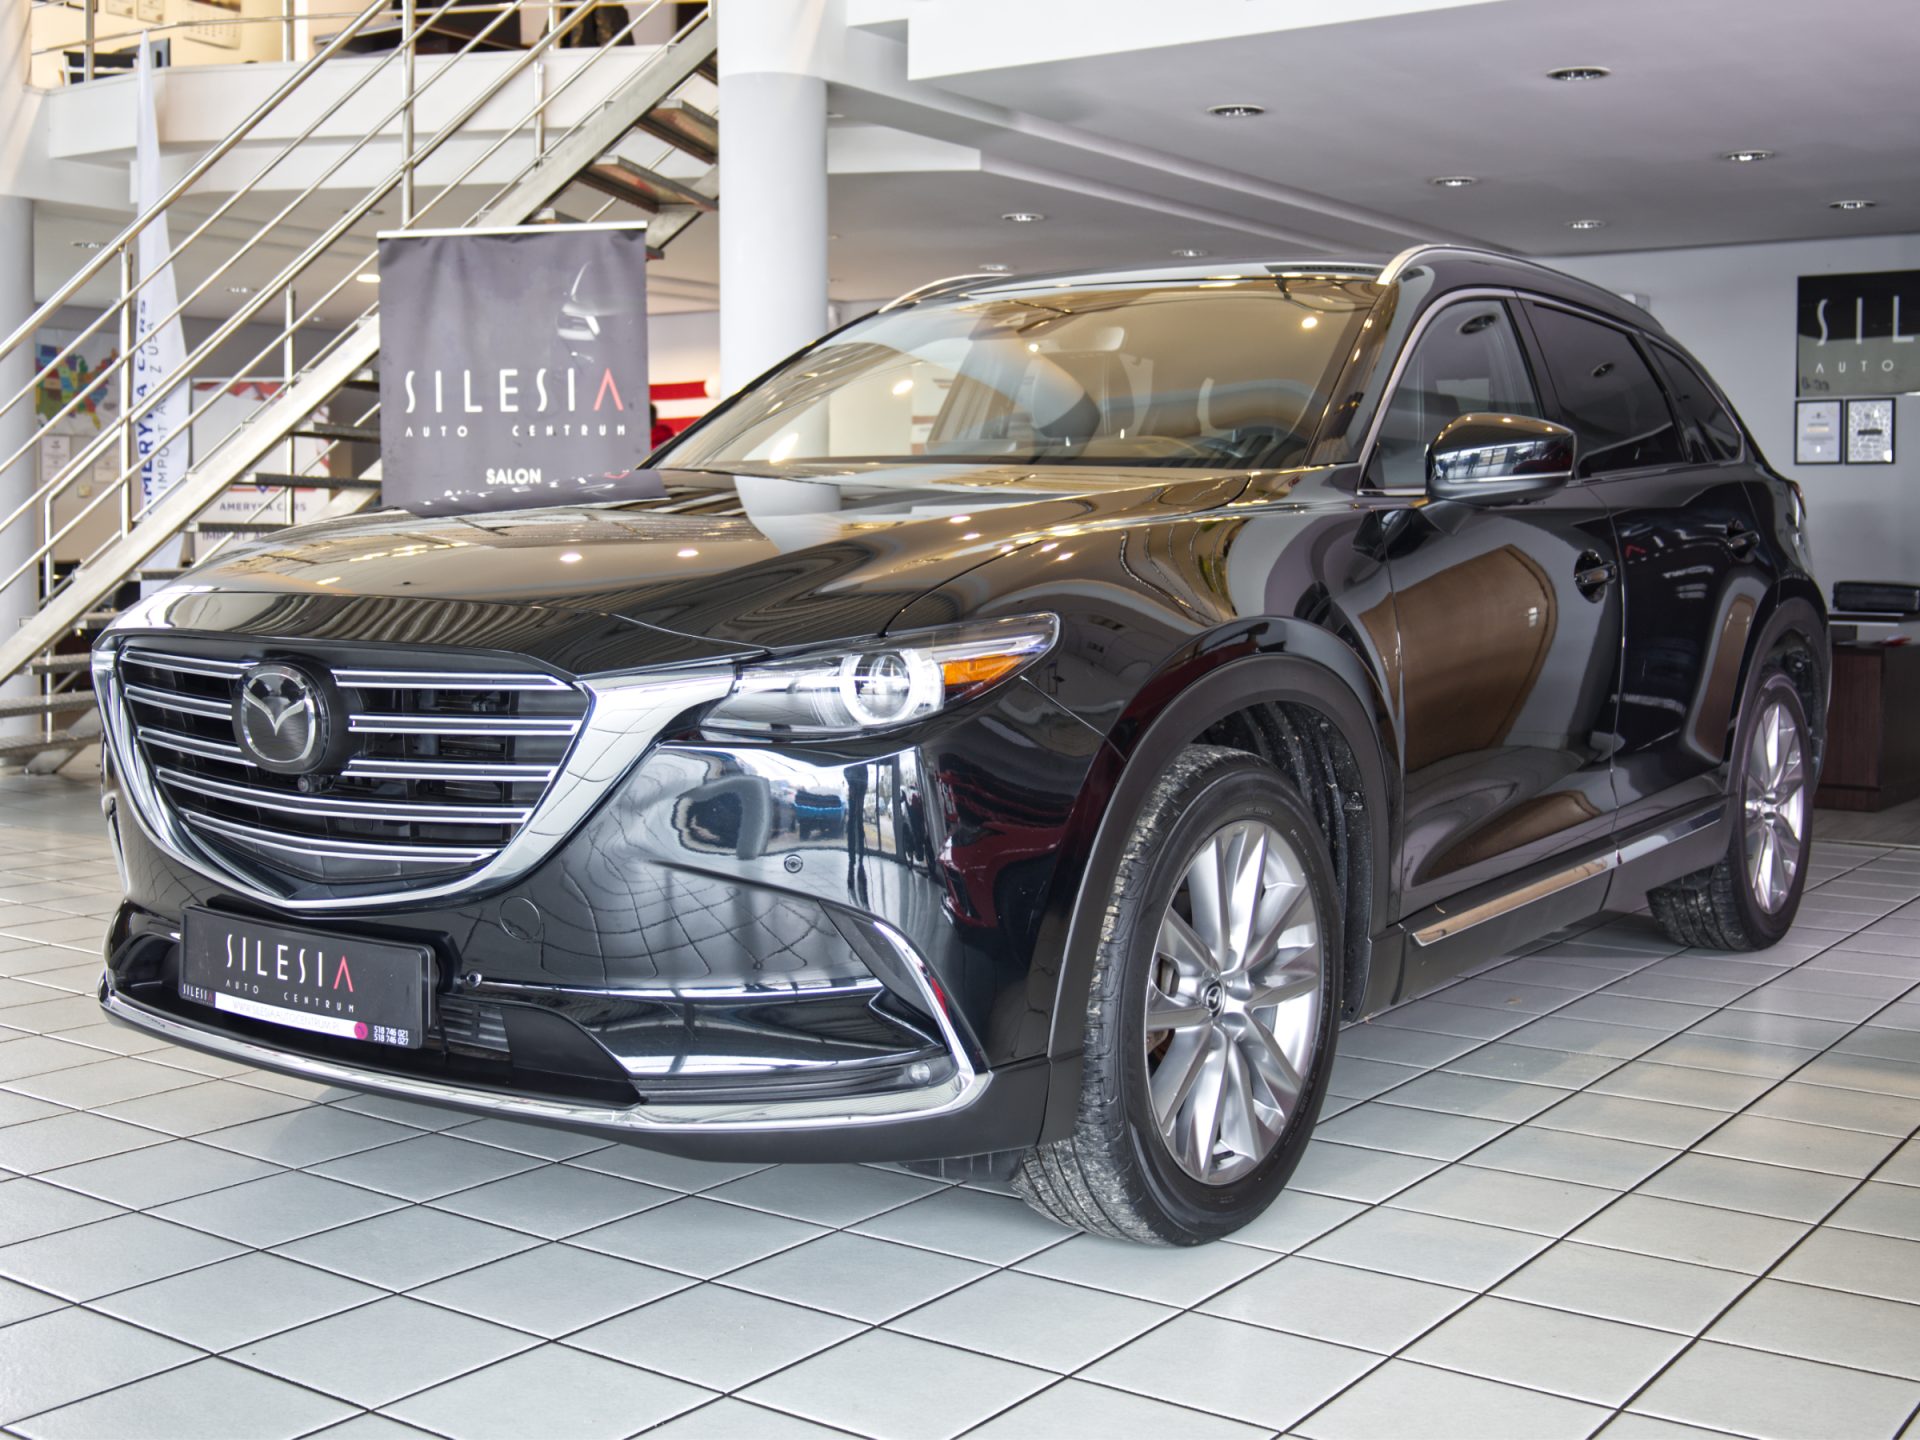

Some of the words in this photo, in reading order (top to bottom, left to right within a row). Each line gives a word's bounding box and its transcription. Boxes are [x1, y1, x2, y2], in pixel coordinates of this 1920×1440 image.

[1815, 360, 1894, 374] AUTO
[405, 367, 624, 413] SILESIA
[405, 425, 468, 437] AUTO
[512, 424, 626, 437] CENTRUM
[486, 468, 541, 485] SALON
[226, 934, 354, 993] SILESIA
[183, 983, 213, 1003] SILESIA
[225, 979, 259, 994] AUTO
[283, 992, 354, 1013] CENTRUM
